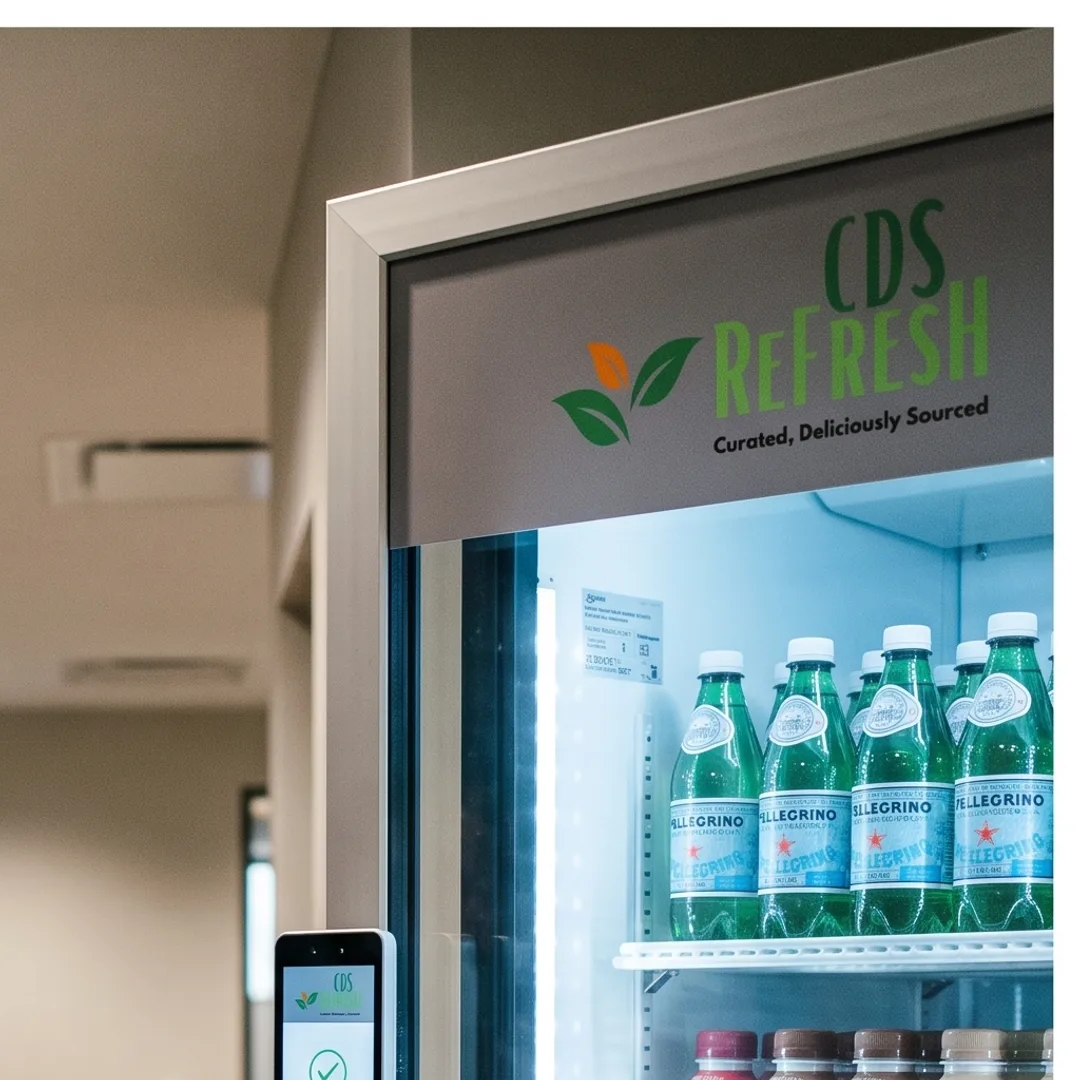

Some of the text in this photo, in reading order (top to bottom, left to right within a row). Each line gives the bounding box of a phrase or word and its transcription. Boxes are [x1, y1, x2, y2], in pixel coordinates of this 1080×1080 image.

[824, 198, 946, 313] CDS
[714, 395, 989, 453] Curated, Deliciously Sourced
[334, 972, 353, 992] CDS
